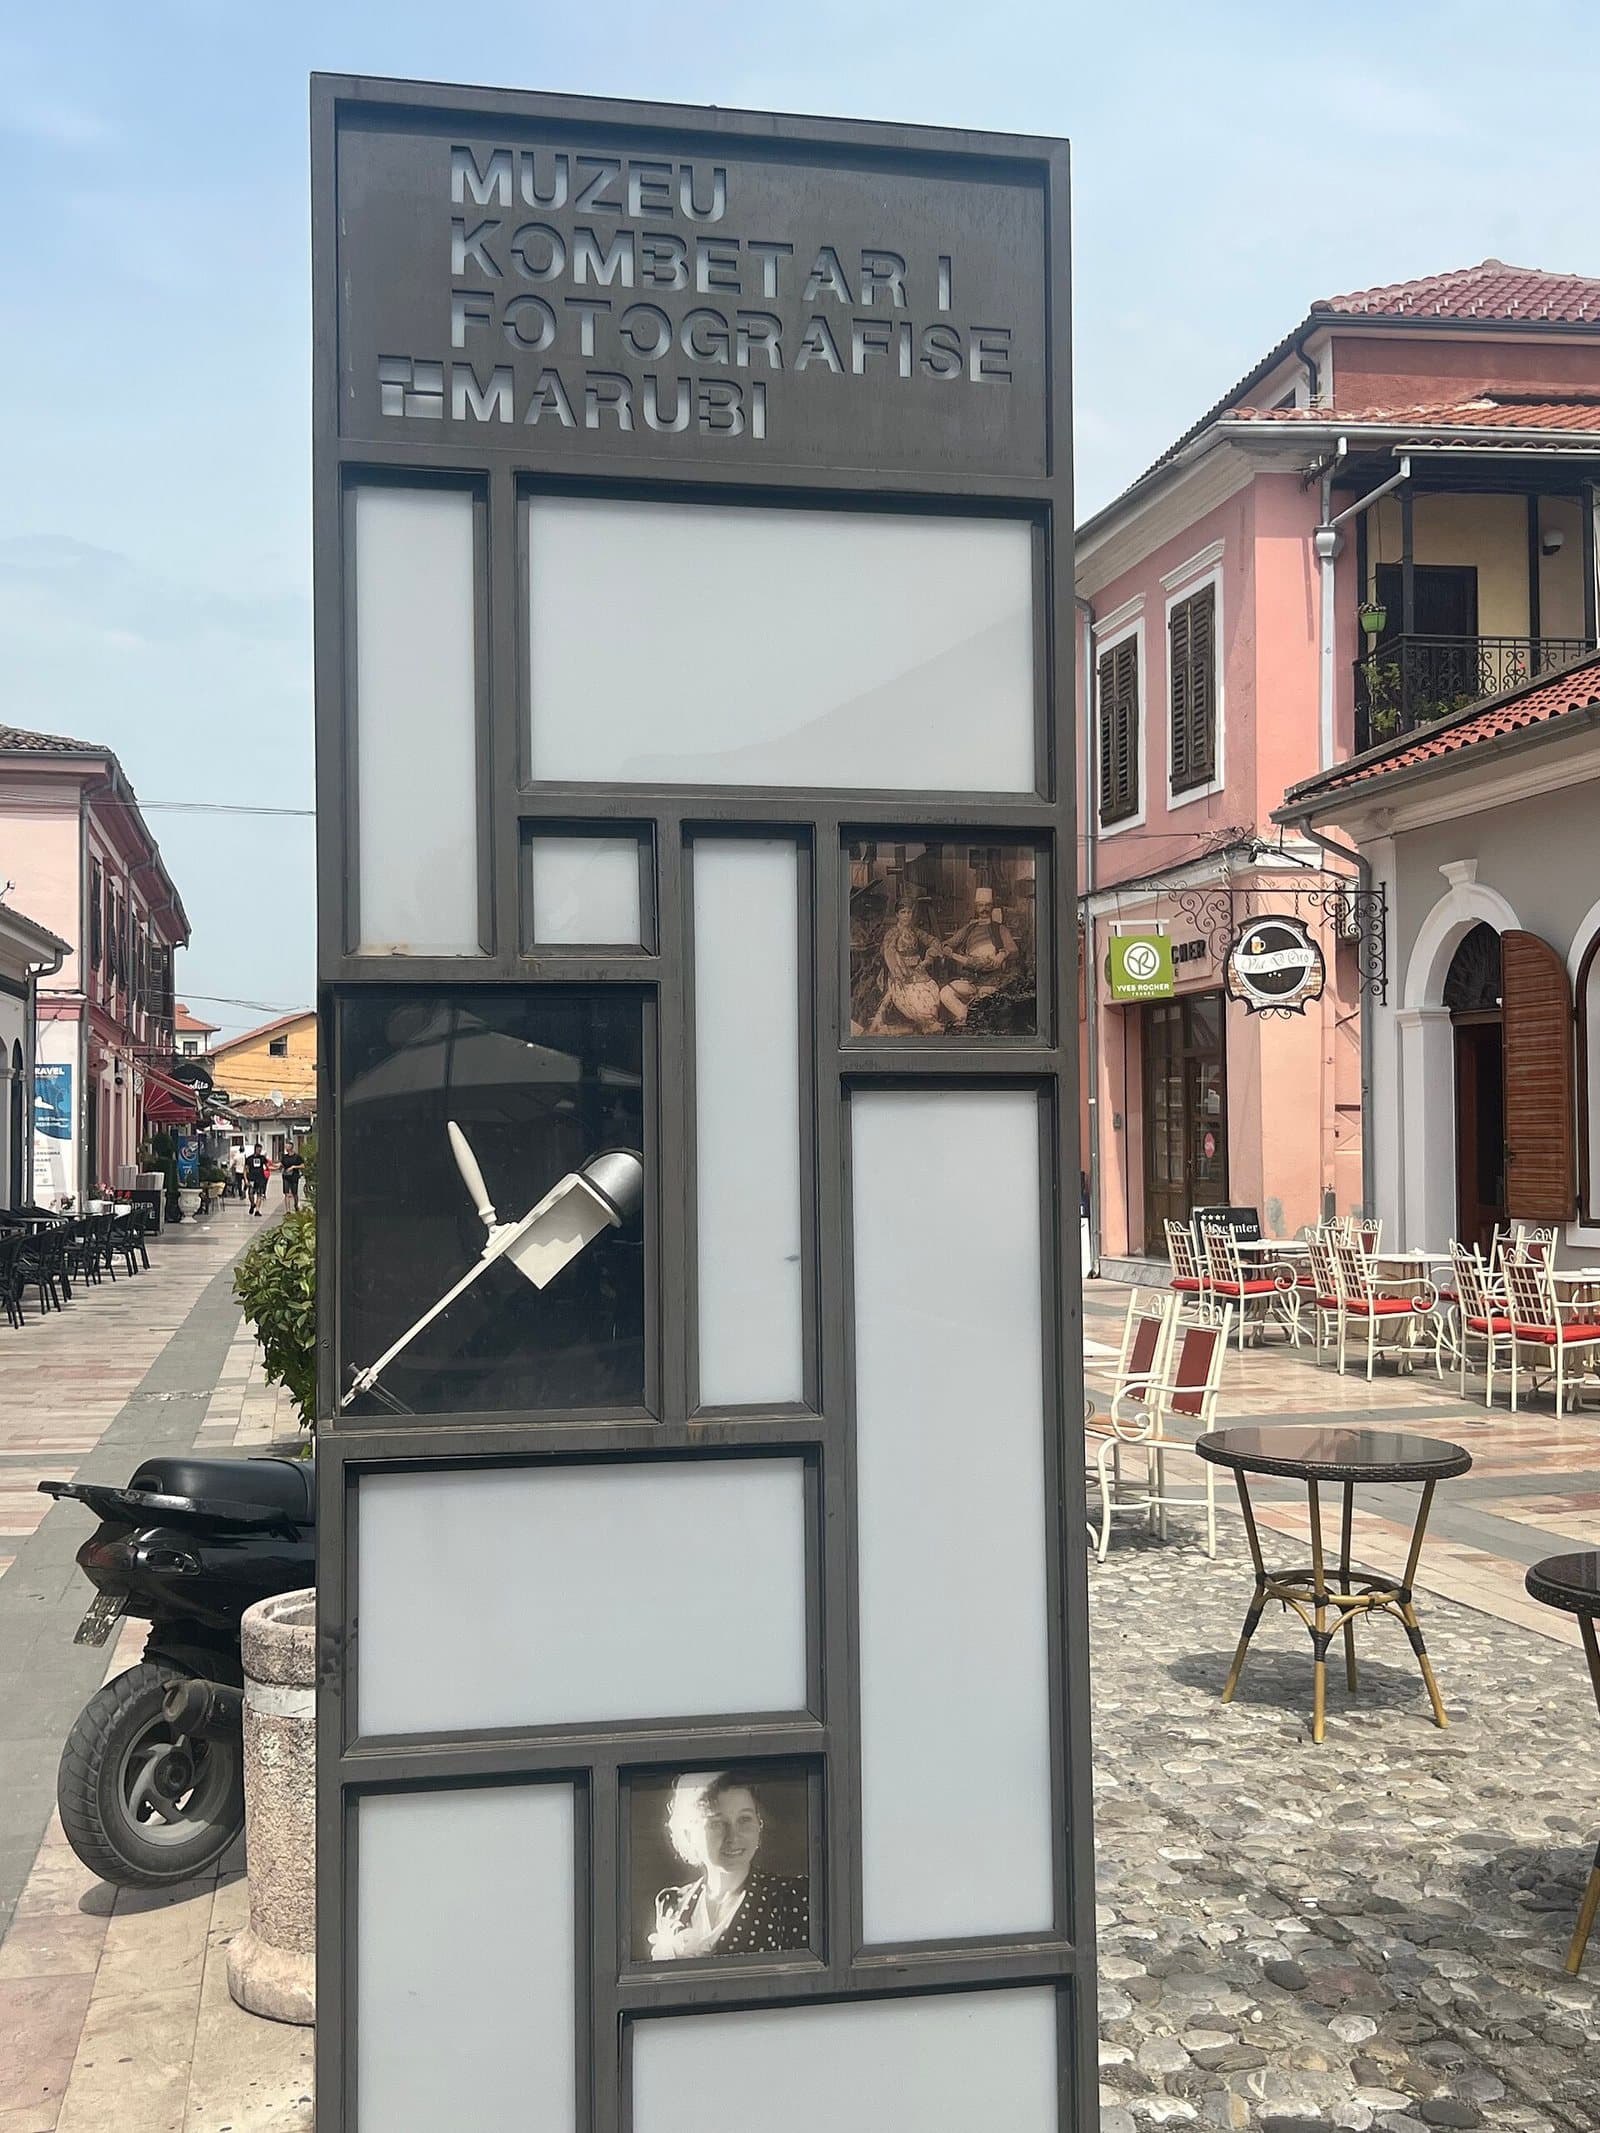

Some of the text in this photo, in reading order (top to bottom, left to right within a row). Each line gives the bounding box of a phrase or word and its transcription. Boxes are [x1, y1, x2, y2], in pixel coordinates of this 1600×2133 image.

[450, 144, 727, 224] MUZEU
[450, 216, 952, 312] KOMBETAR I
[450, 288, 1013, 384] FOTOGRAFISE
[451, 361, 767, 440] MARUBI
[1117, 983, 1169, 992] YVES ROCHER
[34, 1067, 65, 1075] RAVEL
